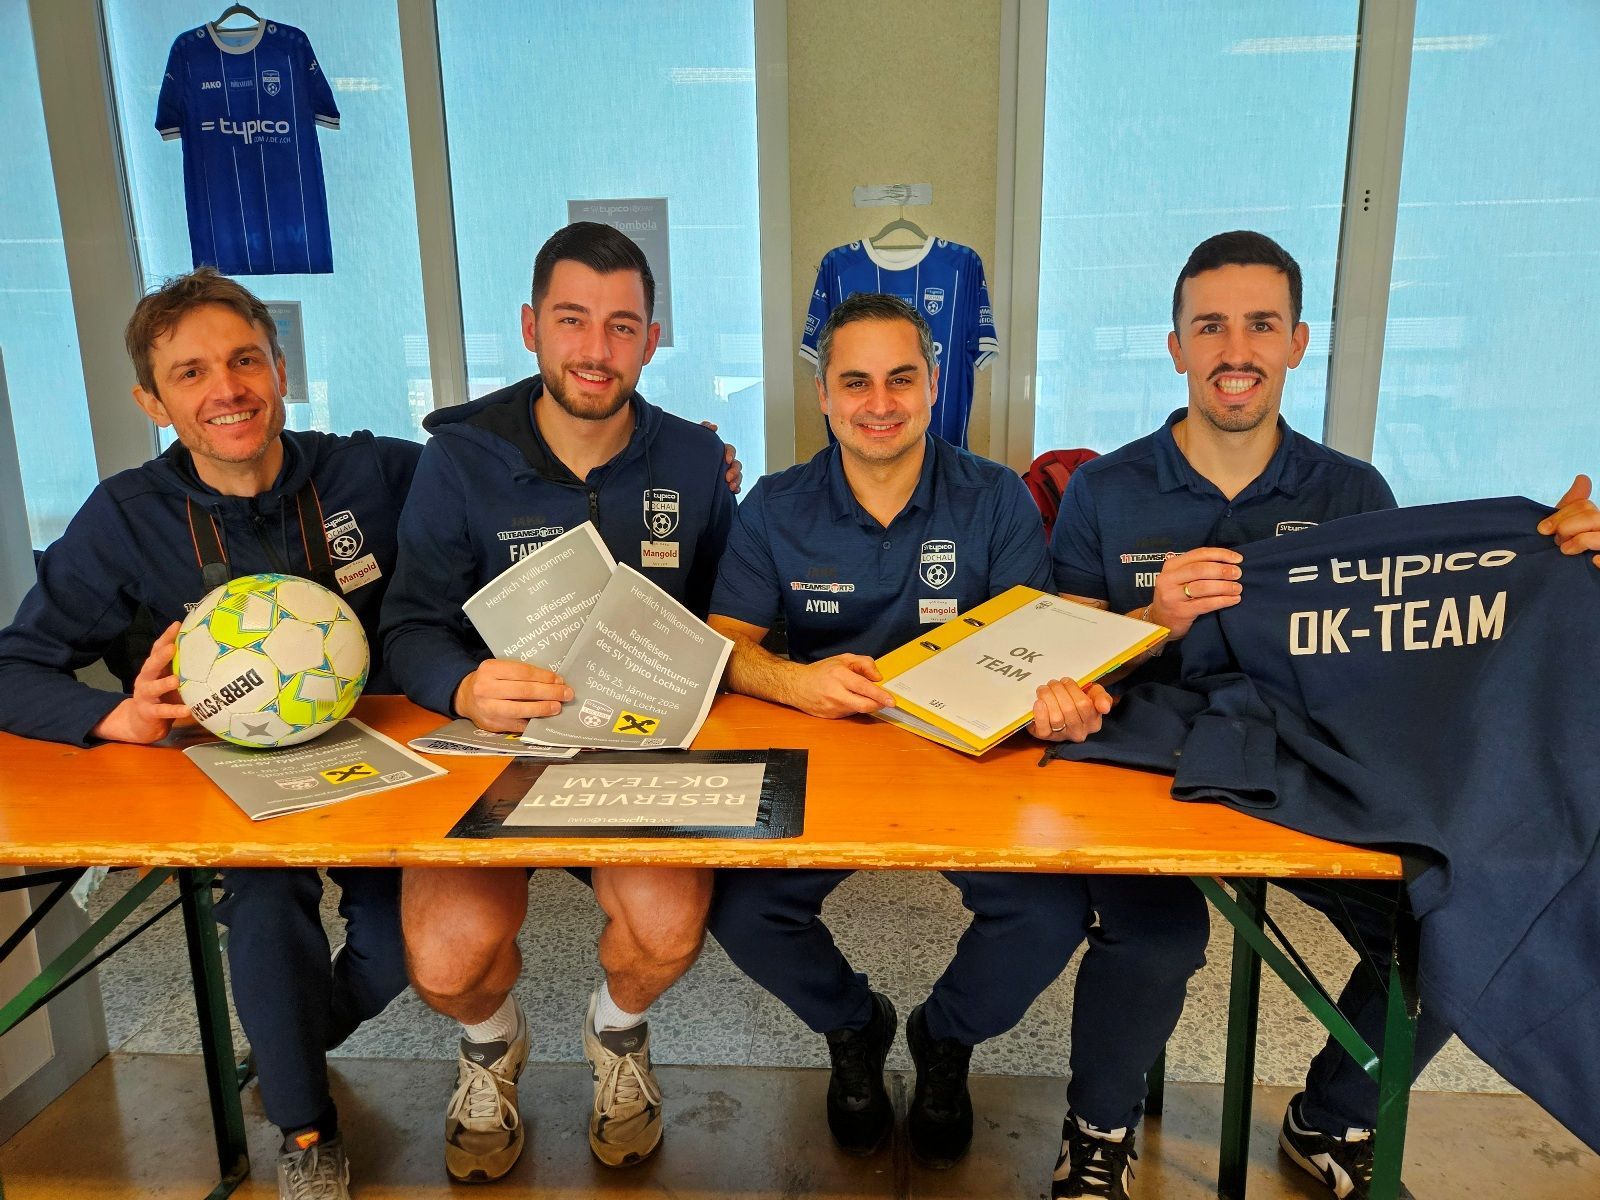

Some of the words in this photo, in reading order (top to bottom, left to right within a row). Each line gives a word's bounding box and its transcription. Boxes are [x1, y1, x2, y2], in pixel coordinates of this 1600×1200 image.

[201, 81, 222, 90] JAKO
[220, 118, 290, 144] typico
[600, 206, 630, 216] typico
[653, 493, 676, 501] typico
[327, 523, 354, 540] OCHAU
[643, 549, 678, 559] Mangold
[929, 544, 953, 552] typico
[338, 561, 377, 585] Mangold
[486, 580, 520, 609] Herzlich
[518, 548, 575, 584] Willkommen
[1331, 550, 1517, 597] typico
[528, 578, 549, 595] zum
[526, 591, 576, 624] Raiffeisen-
[630, 586, 660, 612] Herzlich
[660, 607, 705, 645] Willkommen
[805, 599, 840, 614] AYDIN
[920, 607, 957, 616] Mangold
[652, 620, 670, 635] zum
[1290, 591, 1507, 656] OK-TEAM
[520, 646, 538, 662] des
[537, 637, 550, 650] SV
[549, 621, 581, 641] Typico
[629, 629, 673, 662] Raiffeisen-
[596, 621, 699, 689] Nachwuchshallenturnier
[596, 639, 613, 653] des
[611, 649, 625, 661] SV
[624, 657, 652, 679] Typico
[652, 675, 687, 695] Lochau
[976, 654, 1032, 681] TEAM
[1009, 647, 1044, 663] OK
[190, 668, 265, 722] DERBYSTAR
[585, 660, 597, 673] 16.
[598, 668, 611, 681] bis
[611, 677, 624, 689] 25.
[625, 684, 657, 703] Jänner
[657, 699, 680, 710] 2026
[586, 676, 632, 705] Sporthalle
[633, 700, 668, 716] Lochau
[562, 775, 729, 788] OK-TEAM
[524, 793, 745, 807] RESERVIERT
